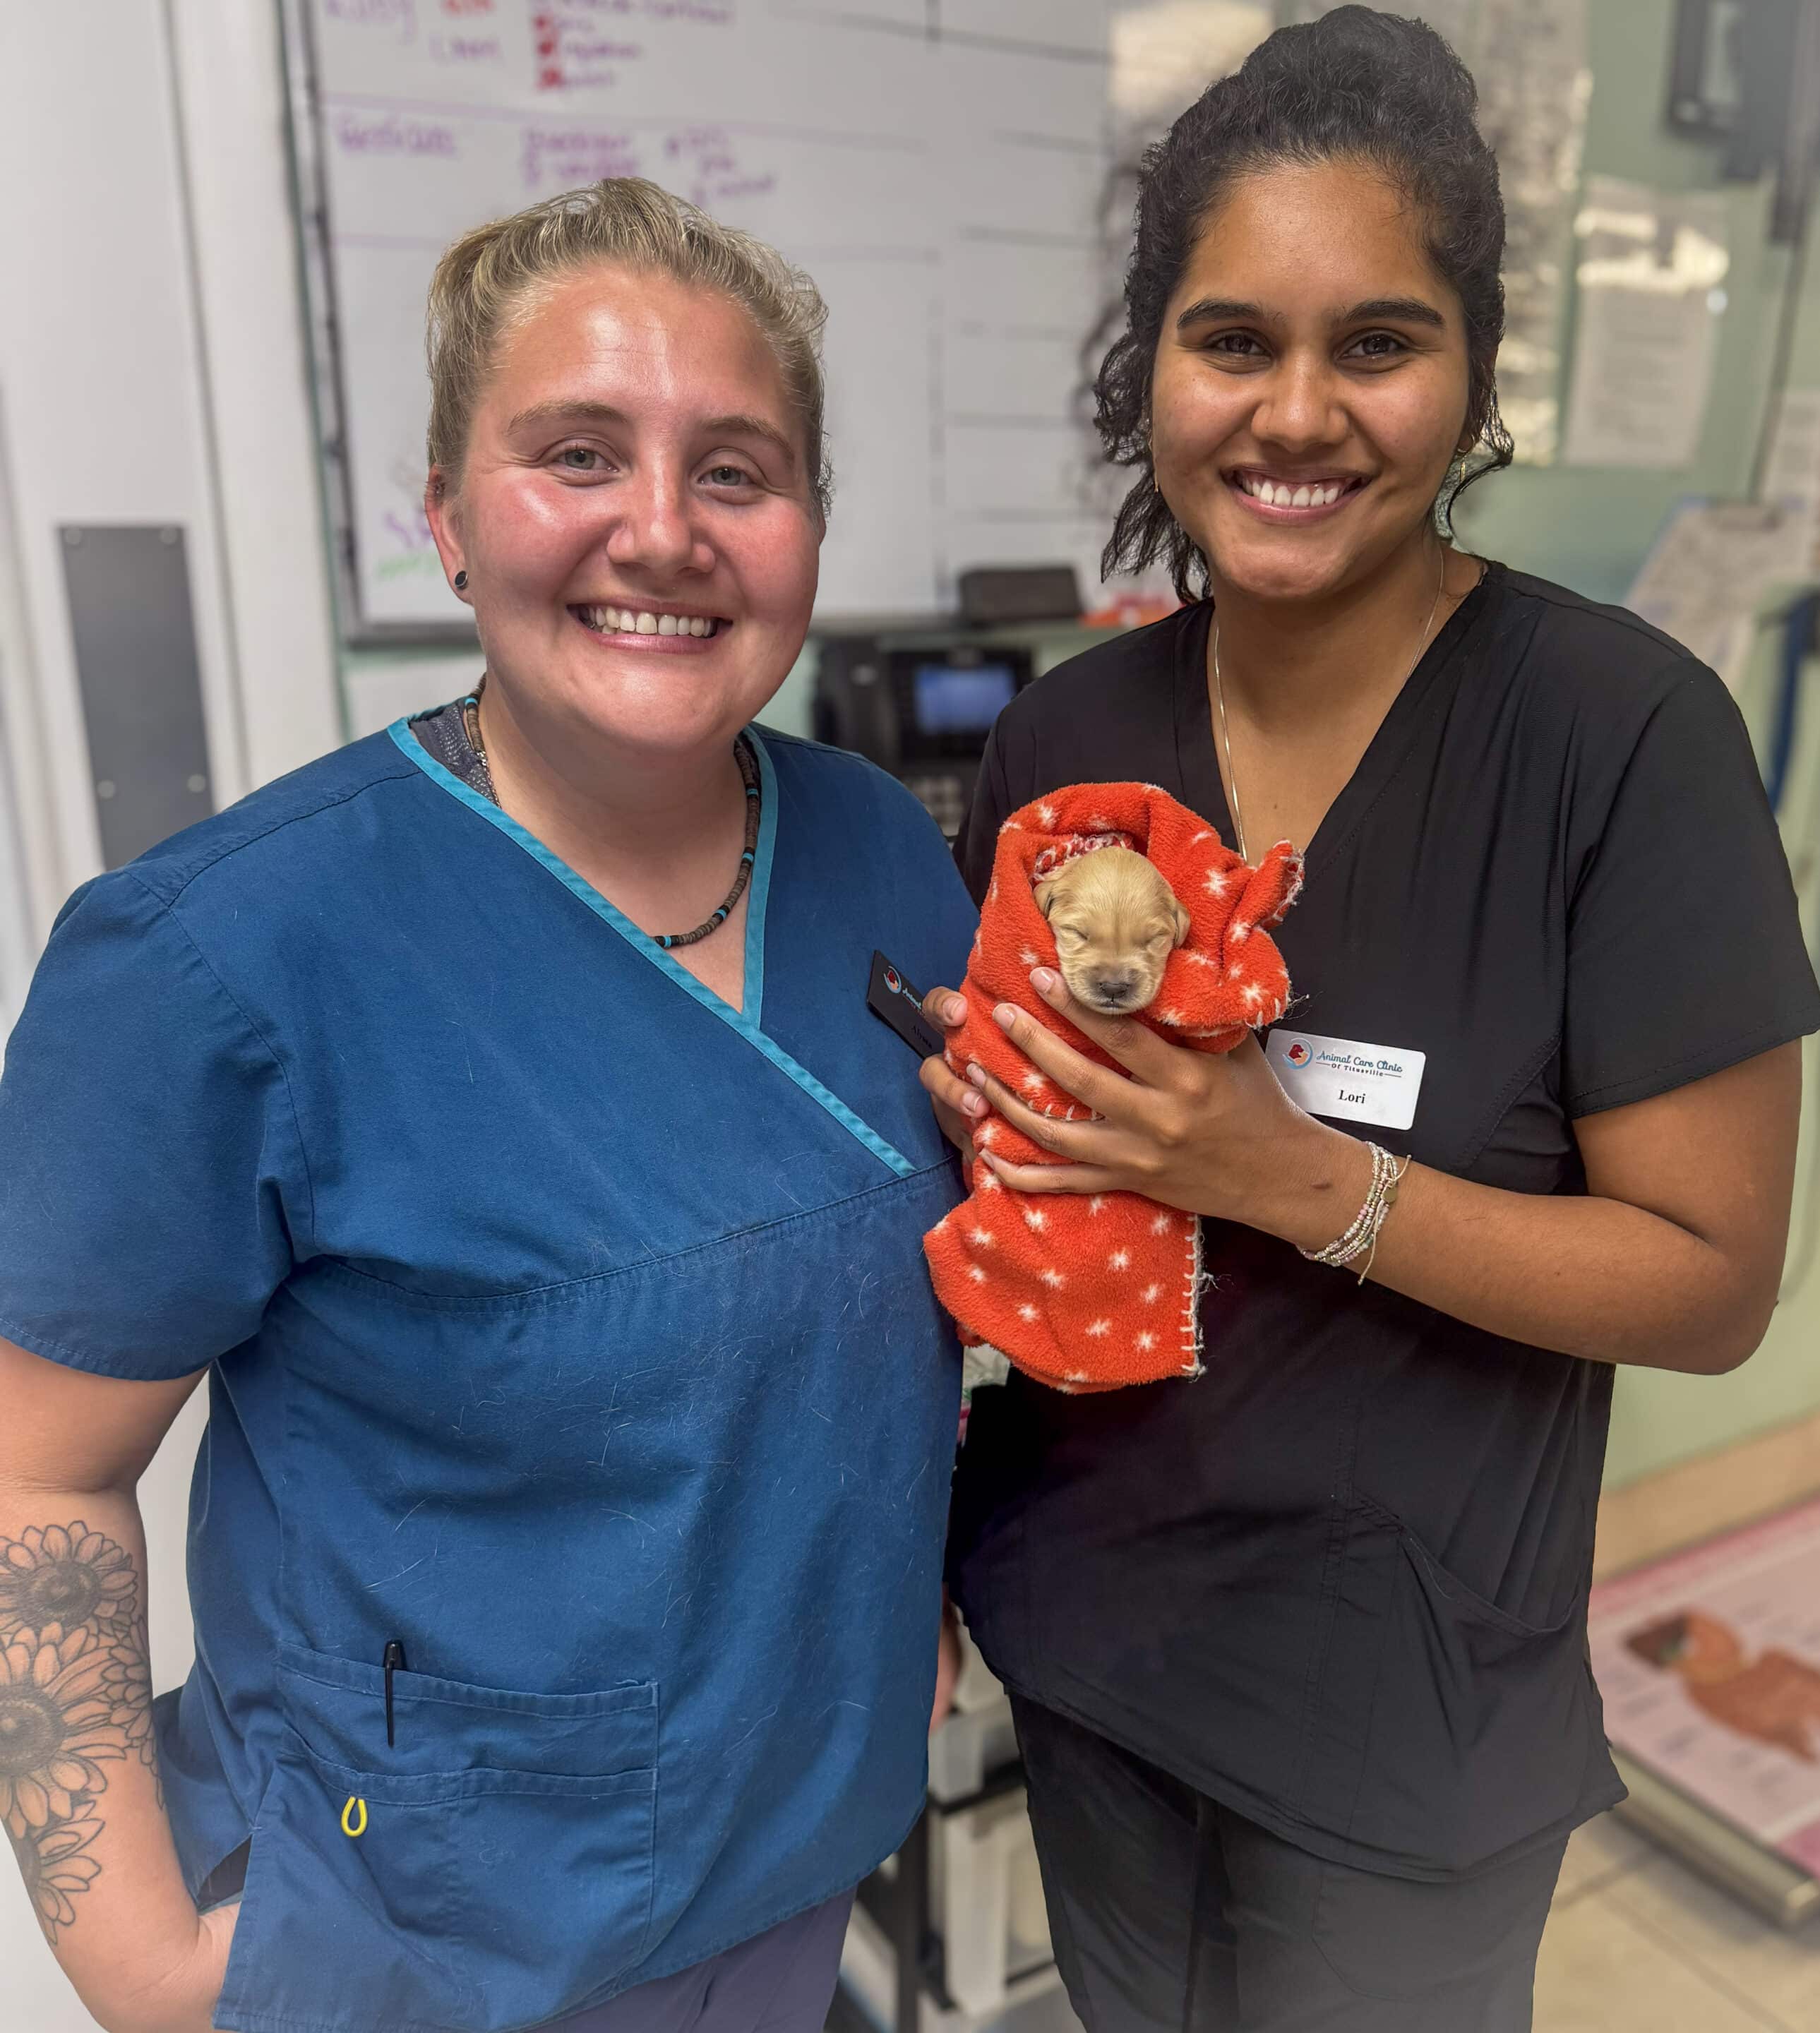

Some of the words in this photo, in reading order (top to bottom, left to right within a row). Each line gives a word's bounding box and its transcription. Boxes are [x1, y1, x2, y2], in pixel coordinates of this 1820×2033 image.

[1317, 1050, 1351, 1064] Animal
[1353, 1057, 1374, 1067] Care
[1377, 1060, 1403, 1073] Clinic
[1344, 1065, 1384, 1077] Titusville
[1339, 1089, 1366, 1103] Lori
